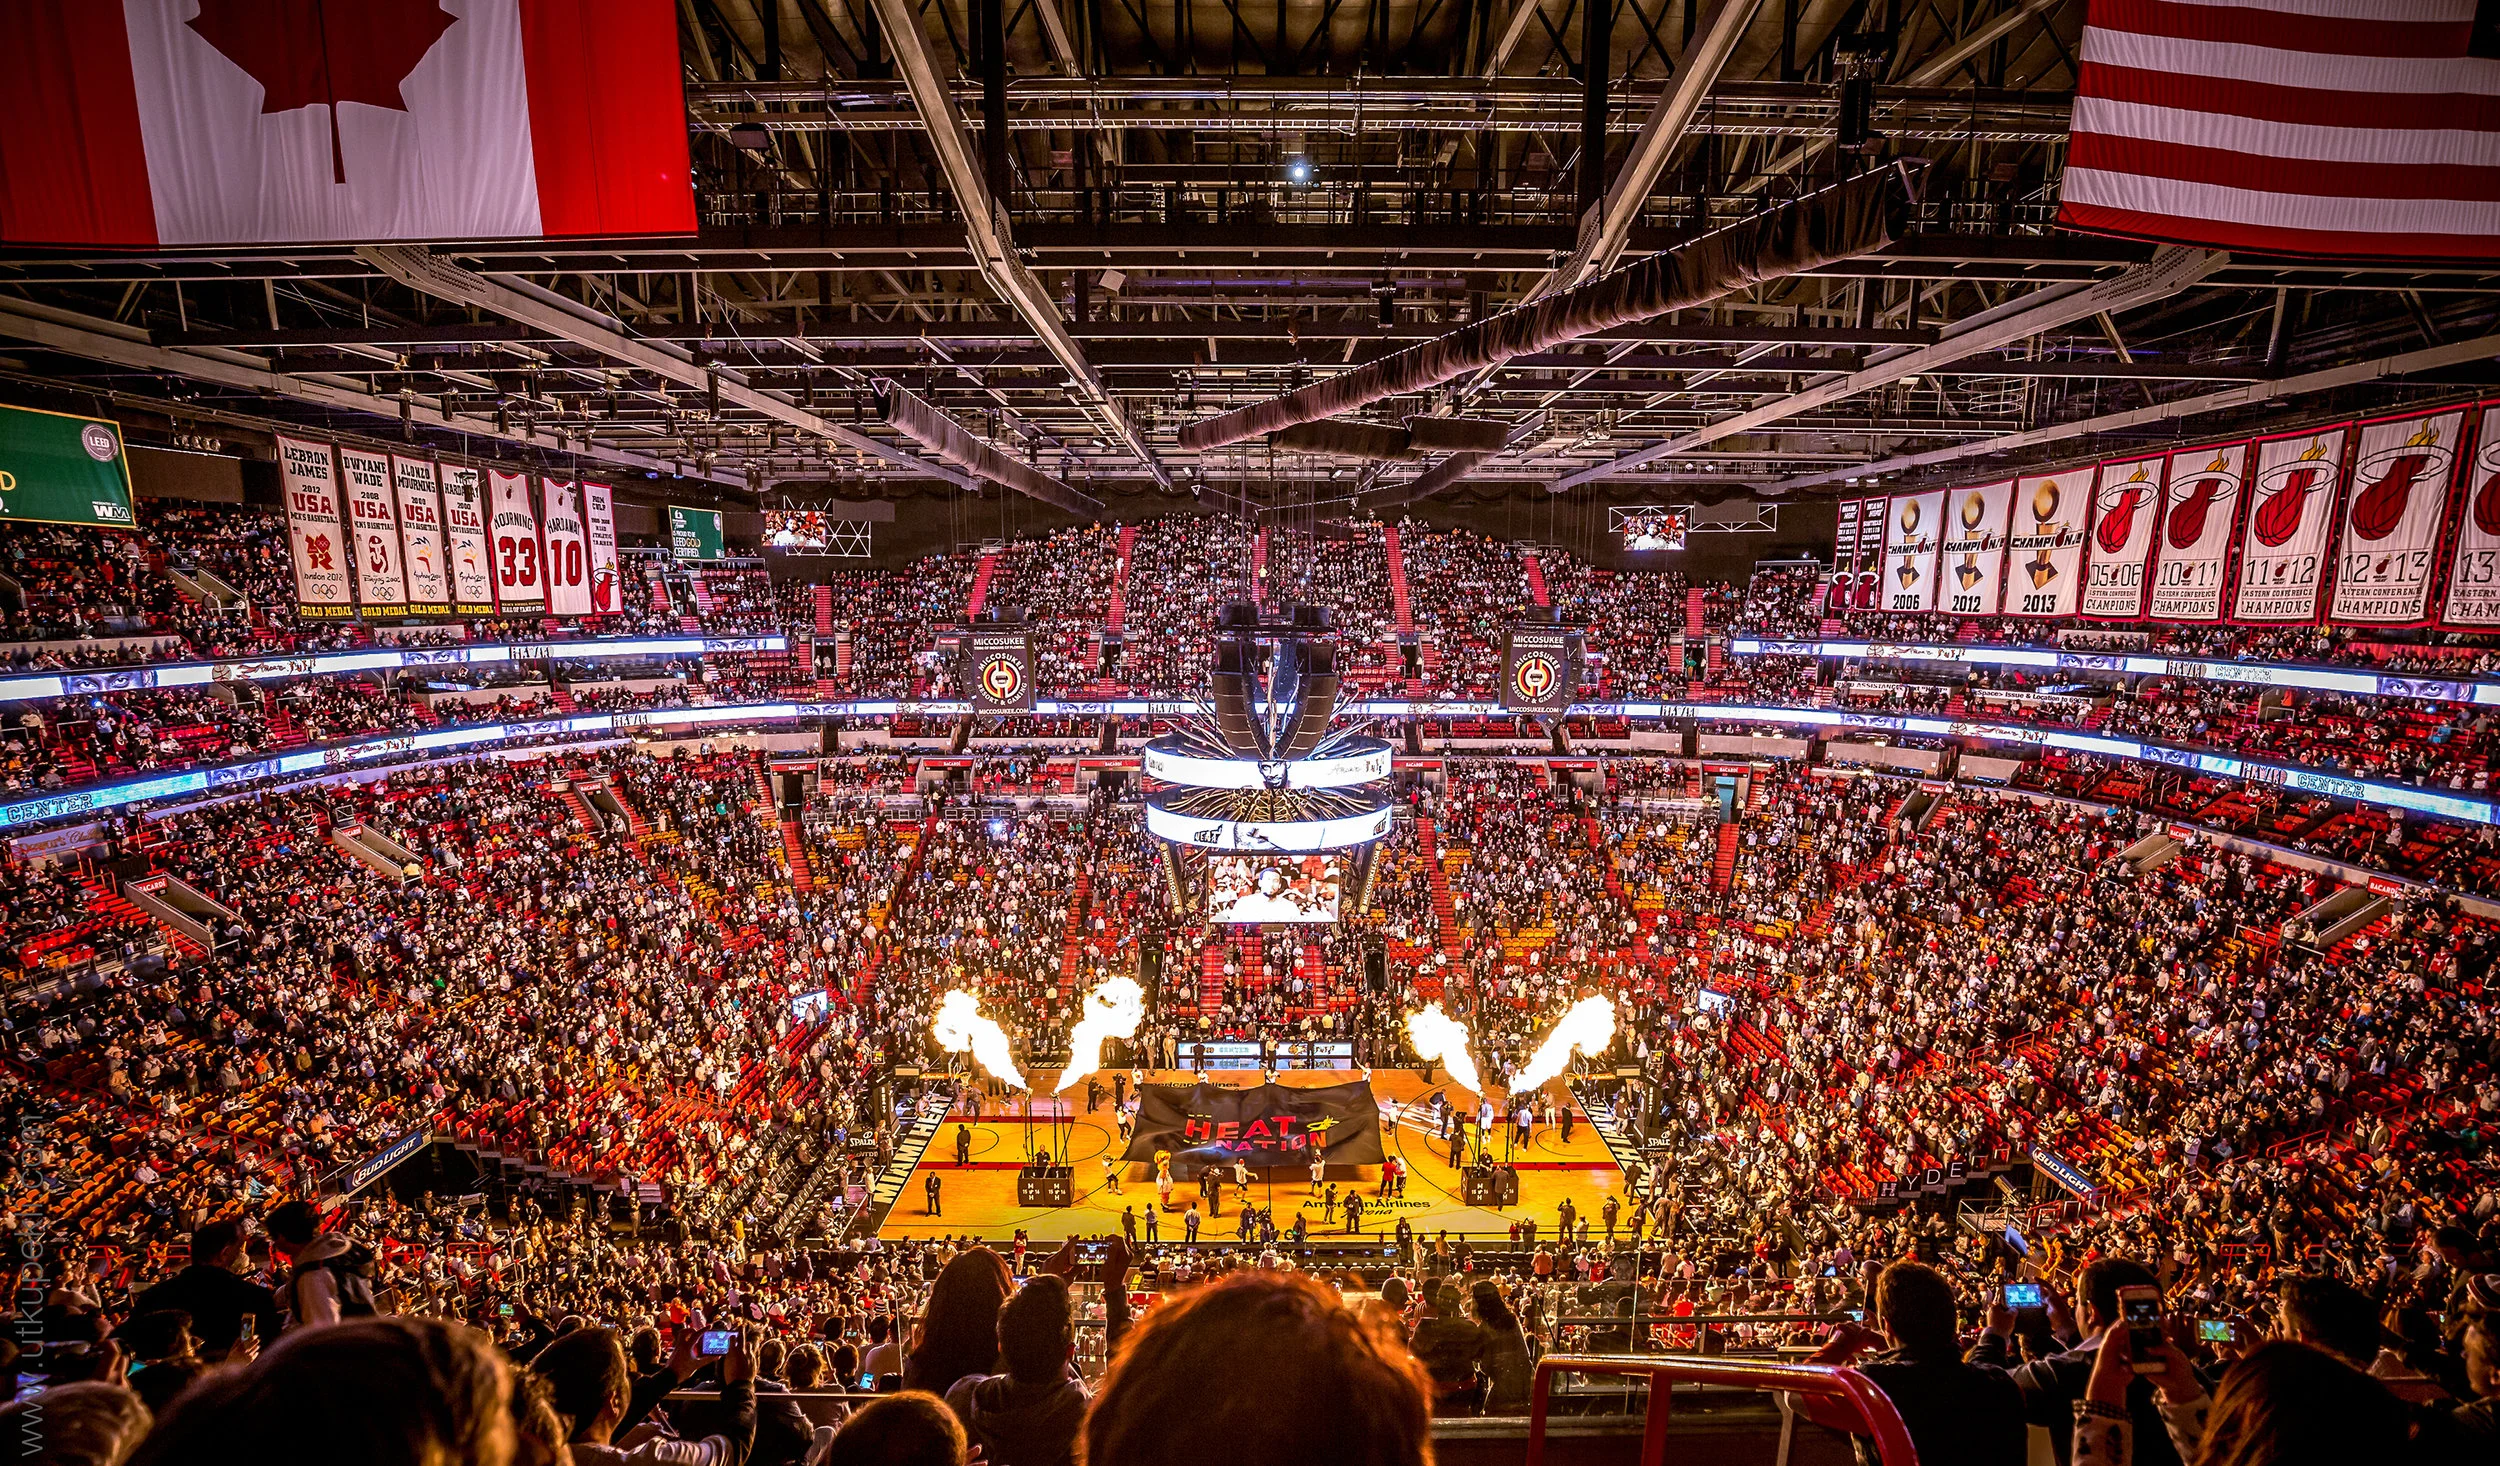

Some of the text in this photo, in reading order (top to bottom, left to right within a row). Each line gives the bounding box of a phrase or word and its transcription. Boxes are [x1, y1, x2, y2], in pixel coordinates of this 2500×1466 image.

[89, 436, 110, 448] LEED
[284, 446, 329, 465] LEBRON
[342, 456, 387, 474] DWYANE
[290, 462, 328, 480] JAMES
[352, 471, 383, 487] WADE
[400, 463, 430, 479] ALONZO
[302, 484, 321, 494] 2012
[397, 475, 436, 493] MOURNING
[291, 492, 334, 514] USA
[360, 491, 379, 500] 2008
[352, 499, 391, 519] USA
[404, 504, 436, 523] USA
[450, 509, 480, 527] USA
[493, 511, 533, 531] MOURNING
[546, 517, 580, 536] HARDAWAY
[673, 537, 701, 547] LEED GOLD
[498, 536, 536, 587] 33
[551, 539, 582, 587] 10
[2246, 555, 2316, 585] 11 12
[2341, 553, 2371, 583] 12
[2460, 551, 2497, 583] 13
[2090, 563, 2109, 586] 05
[2159, 560, 2217, 585] 10 11
[2271, 588, 2313, 597] CONFERENCE
[2372, 587, 2422, 596] CONFERENCE
[2453, 589, 2497, 597] EASTERN
[301, 605, 353, 616] GOLD MEDAL
[361, 605, 408, 616] GOLD MEDAL
[410, 604, 450, 614] GOLD MEDAL
[457, 604, 494, 614] GOLD MEDAL
[1893, 595, 1920, 610] 2006
[1952, 595, 1981, 612] 2012
[2022, 594, 2057, 612] 2013
[2153, 600, 2215, 613] CHAMPIONS
[2451, 602, 2500, 617] CHAM
[973, 637, 1025, 645] MICCOSUKEE
[1513, 635, 1564, 644] MICCOSUKEE
[978, 652, 1025, 672] MICCOSUKEE
[1514, 651, 1561, 670] MICCOSUKEE
[977, 683, 999, 705] RESORT
[1007, 682, 1028, 704] GAMING
[1511, 681, 1530, 703] RESORT
[1538, 681, 1561, 703] GAMING
[2033, 694, 2060, 702] Location
[2298, 773, 2365, 798] CENTER
[6, 793, 94, 823] CENTER
[1194, 824, 1223, 844] HEAT
[1162, 851, 1180, 905] MICCOSUKEE.COM
[1362, 850, 1380, 906] MICCOSUKEE.COM
[1184, 1115, 1297, 1141] HEAT
[1215, 1131, 1327, 1152] NATION
[356, 1137, 416, 1180] BUD LIGHT
[871, 1136, 928, 1204] MIAMI
[2034, 1150, 2091, 1194] BUD LIGHT
